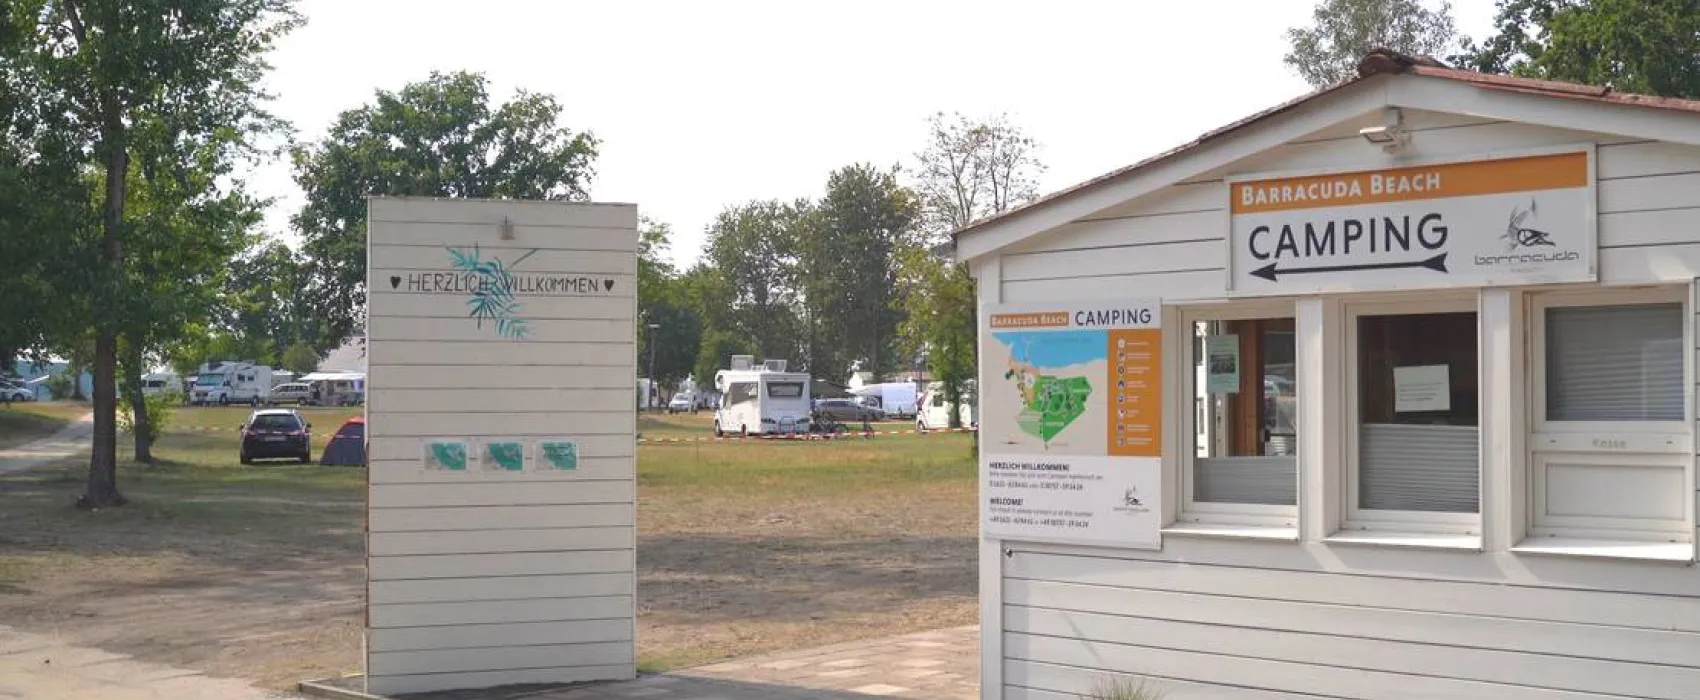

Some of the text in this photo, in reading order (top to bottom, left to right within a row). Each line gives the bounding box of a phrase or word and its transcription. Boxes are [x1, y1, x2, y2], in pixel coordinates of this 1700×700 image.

[1248, 212, 1448, 261] CAMPING
[1474, 250, 1580, 266] barracuda
[408, 274, 598, 293] HERZLICH WILLKOMMEN
[1074, 308, 1151, 326] CAMPING
